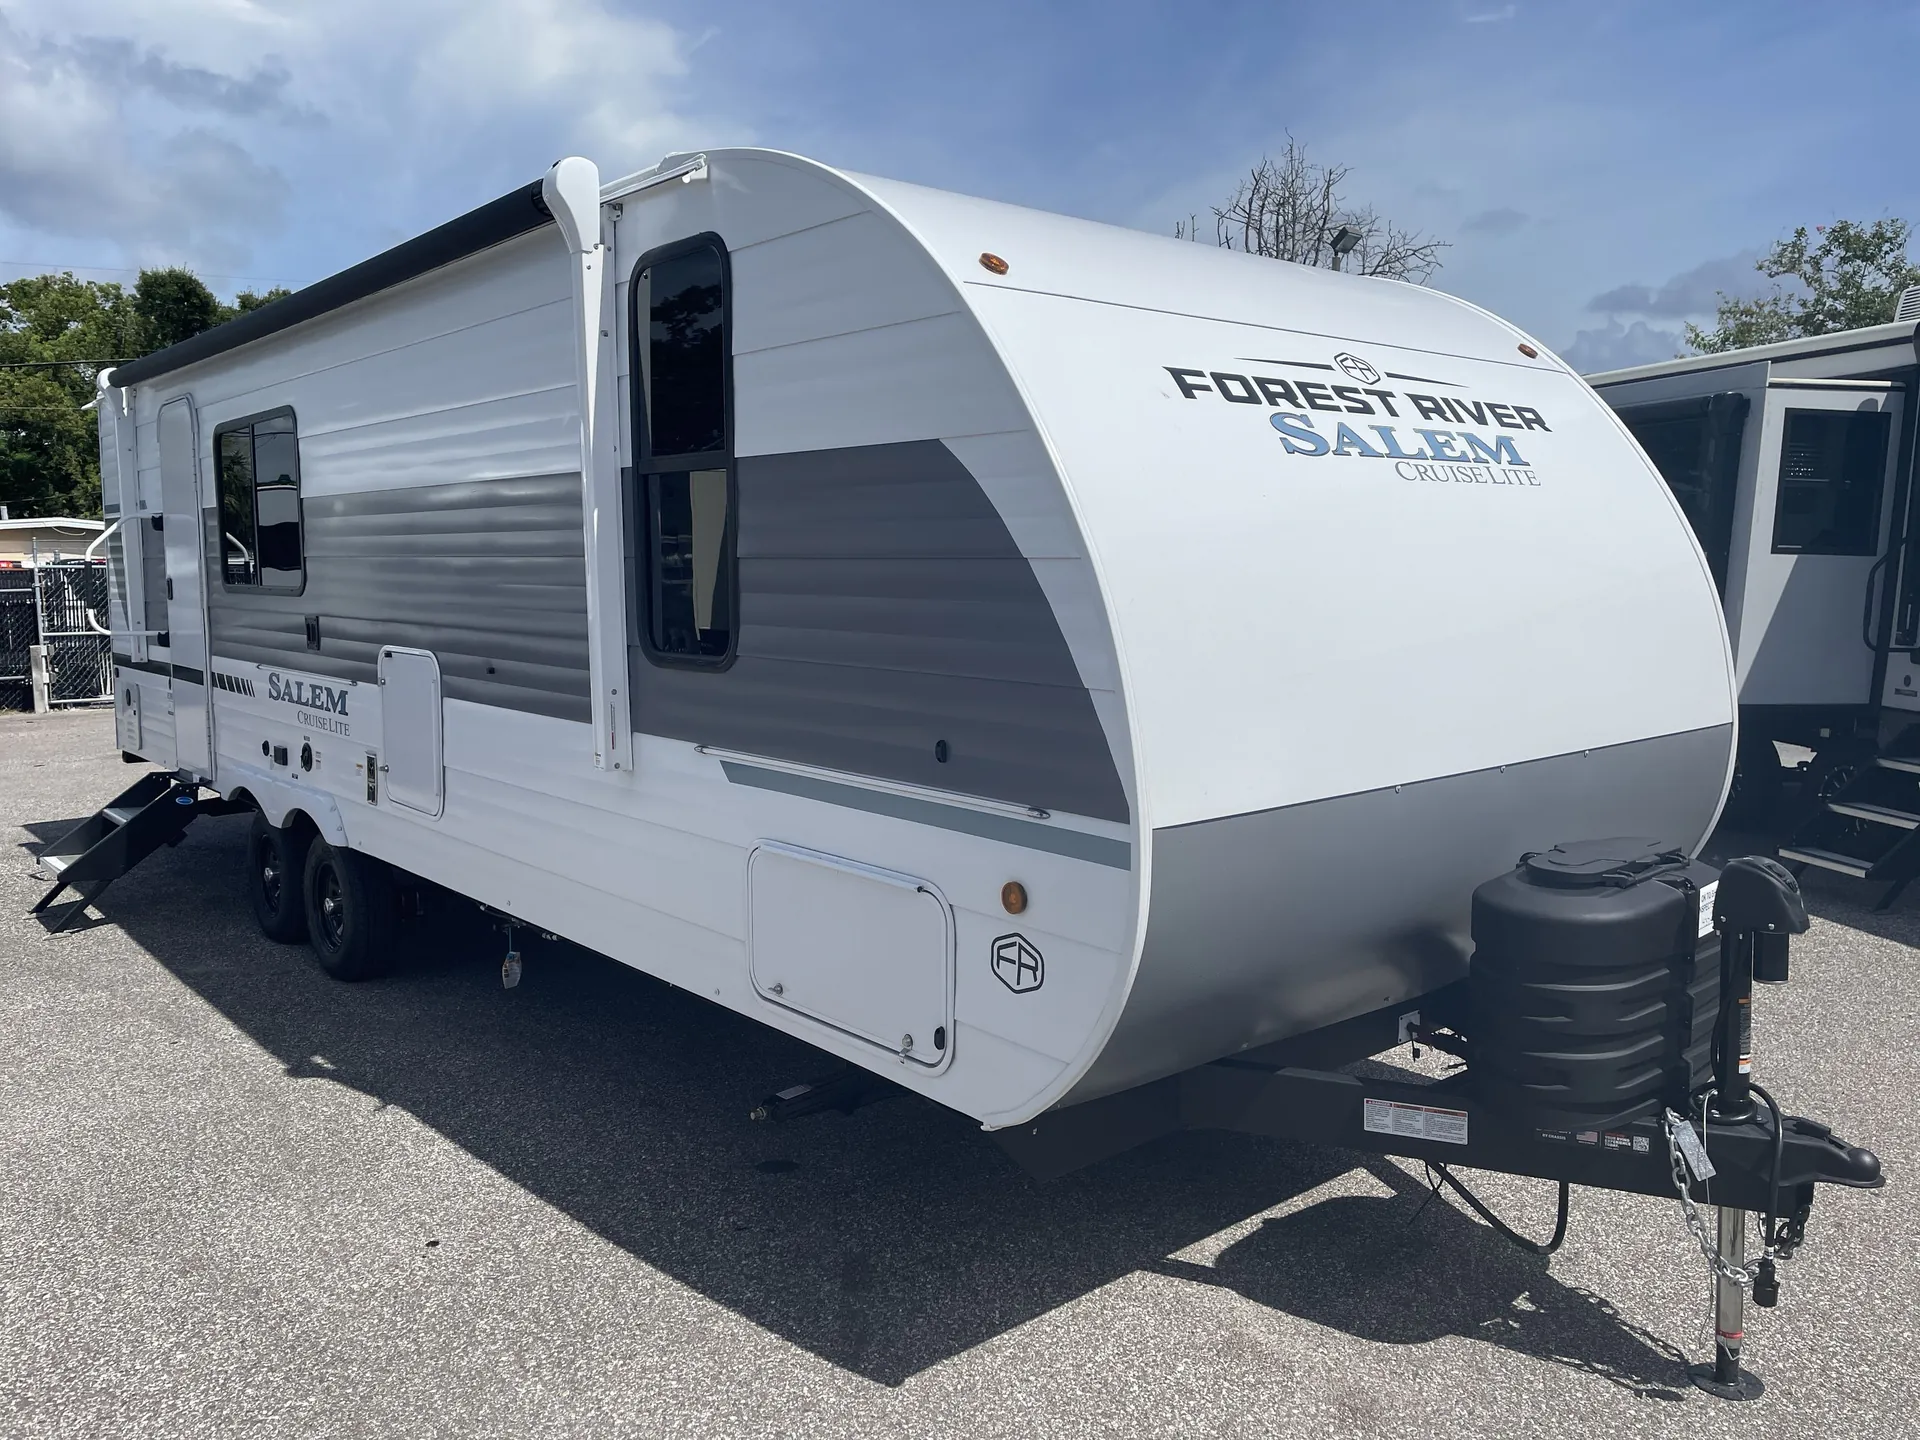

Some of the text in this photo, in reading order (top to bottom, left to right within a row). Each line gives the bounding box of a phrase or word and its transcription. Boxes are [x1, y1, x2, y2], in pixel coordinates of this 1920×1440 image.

[1161, 365, 1552, 432] FOREST RIVER
[1269, 411, 1531, 467] SALEM
[269, 672, 348, 716] SALEM
